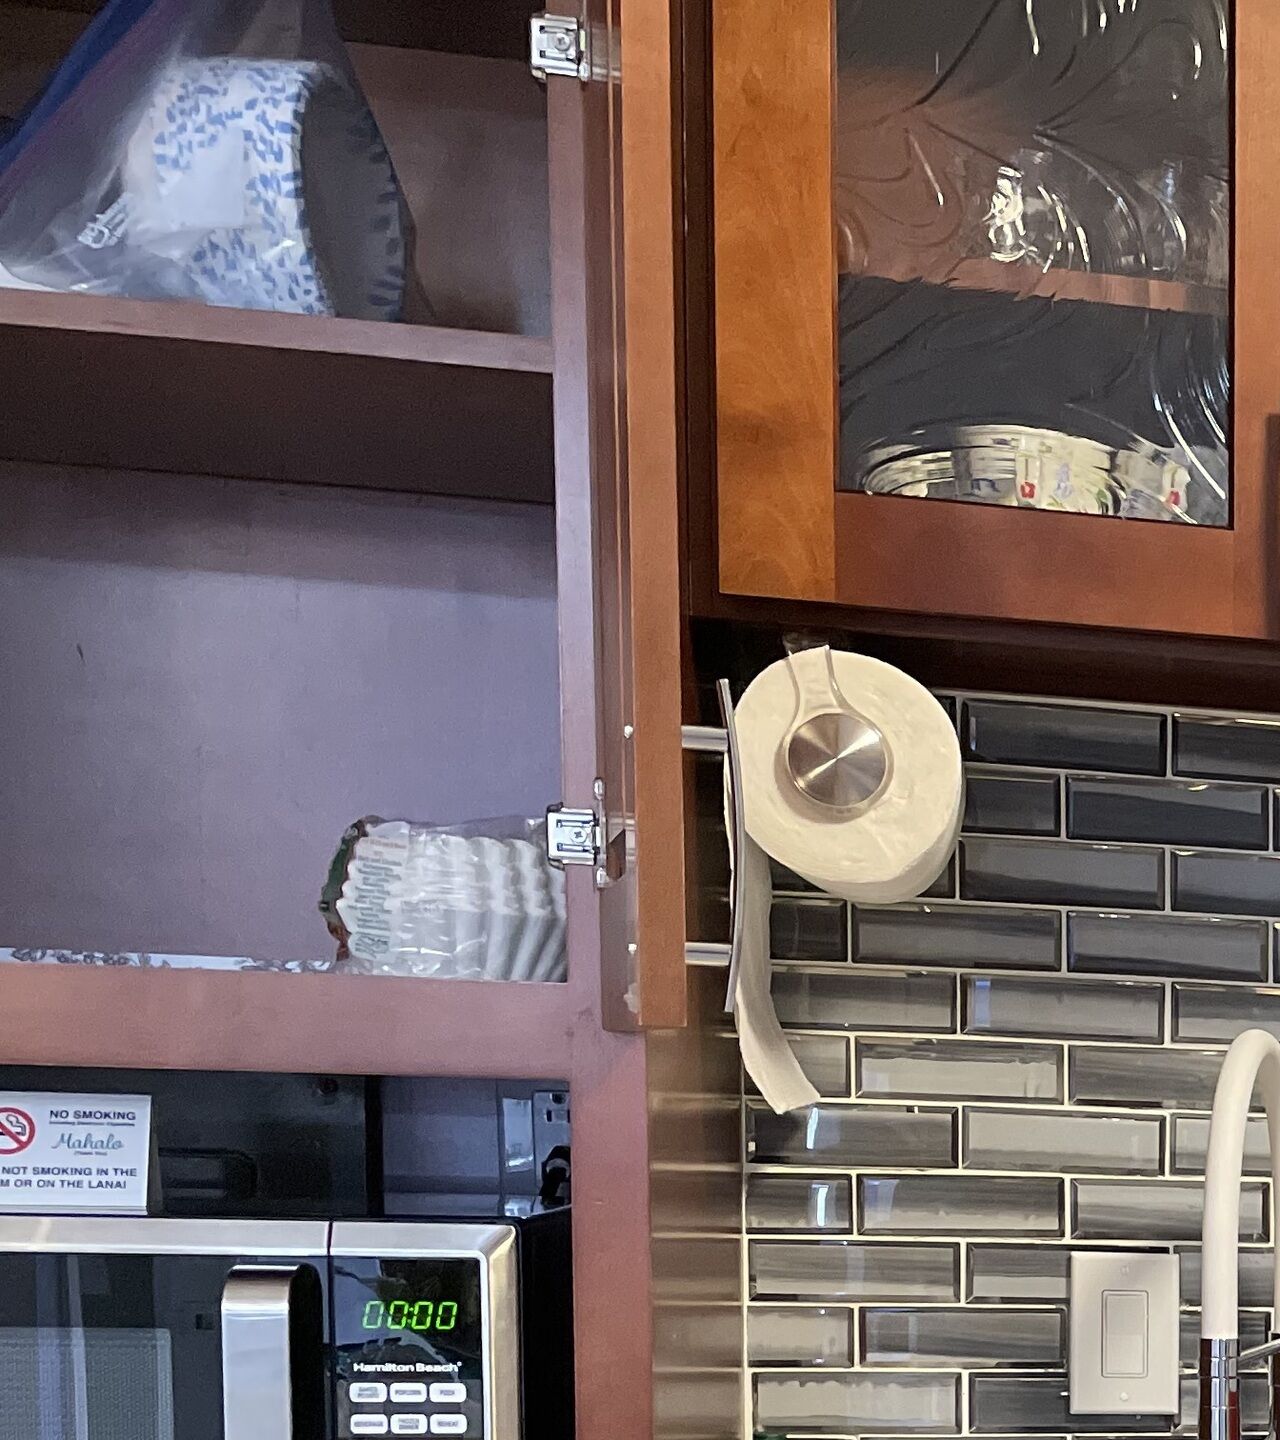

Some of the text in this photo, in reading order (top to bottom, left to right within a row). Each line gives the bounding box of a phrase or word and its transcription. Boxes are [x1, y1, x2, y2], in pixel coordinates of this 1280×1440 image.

[49, 1110, 136, 1120] NO SMOKING
[51, 1132, 124, 1150] Mahalo
[2, 1166, 137, 1177] NOT SMOKING IN THE
[14, 1180, 32, 1188] OR
[37, 1180, 55, 1188] ON
[60, 1180, 84, 1188] THE
[88, 1181, 127, 1189] LANAI
[353, 1363, 415, 1372] Hamilton
